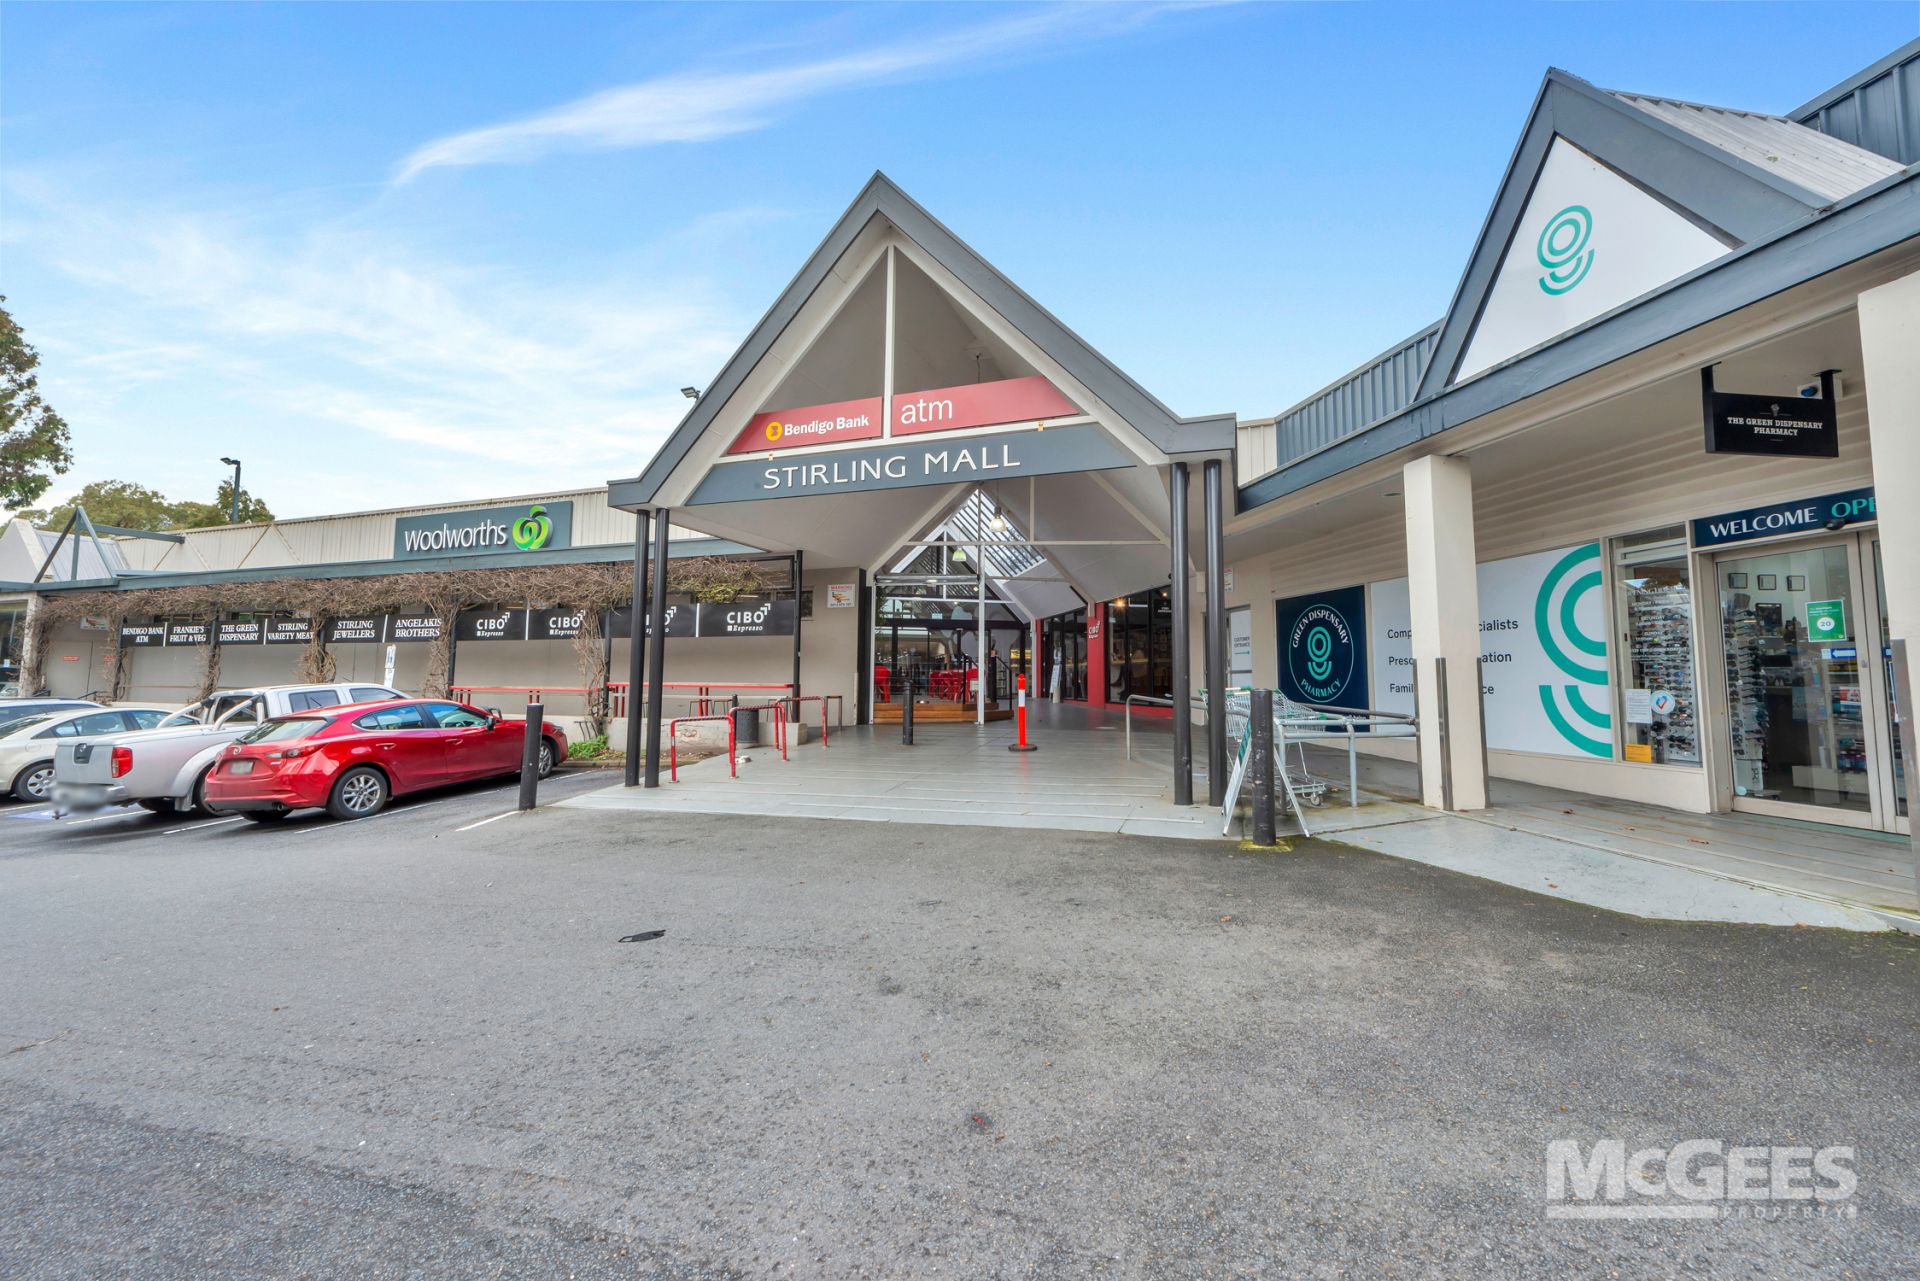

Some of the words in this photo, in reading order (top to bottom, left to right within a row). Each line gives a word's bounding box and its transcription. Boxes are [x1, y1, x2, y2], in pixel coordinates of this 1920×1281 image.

[900, 396, 953, 425] atm
[783, 420, 834, 437] Bendigo
[835, 414, 869, 430] Bank
[1746, 418, 1773, 426] GREEN
[1775, 420, 1823, 429] DISPENSARY
[1754, 427, 1798, 436] PHARMACY
[763, 455, 906, 490] STIRLING
[924, 444, 1021, 475] MALL
[1710, 506, 1818, 538] WELCOME
[404, 519, 507, 551] Woolworths
[395, 618, 442, 628] ANGELAKIS
[549, 616, 580, 628] CIBO
[726, 611, 765, 624] CIBO
[173, 625, 205, 634] FRANKIE'S
[221, 624, 235, 633] THE
[236, 623, 259, 632] GREEN
[277, 622, 308, 631] STIRLING
[337, 620, 374, 629] STIRLING
[476, 619, 505, 630] CIBO
[1292, 616, 1309, 648] GREEN
[1308, 609, 1349, 644] DISPENSARY
[1387, 629, 1412, 639] Comp
[1479, 619, 1519, 632] cialists
[122, 627, 148, 635] BENDIGO
[148, 626, 164, 635] BANK
[267, 632, 295, 640] VARIETY
[295, 631, 315, 640] MEAT
[332, 629, 375, 640] JEWELLERS
[395, 628, 440, 638] BROTHERS
[136, 635, 149, 643] ATM
[169, 634, 187, 642] FRUIT
[193, 634, 206, 642] VEG
[219, 632, 260, 641] DISPENSARY
[1388, 656, 1414, 666] Presc
[1481, 651, 1512, 663] ation
[1301, 678, 1341, 697] PHARMACY
[1389, 683, 1414, 693] Famil
